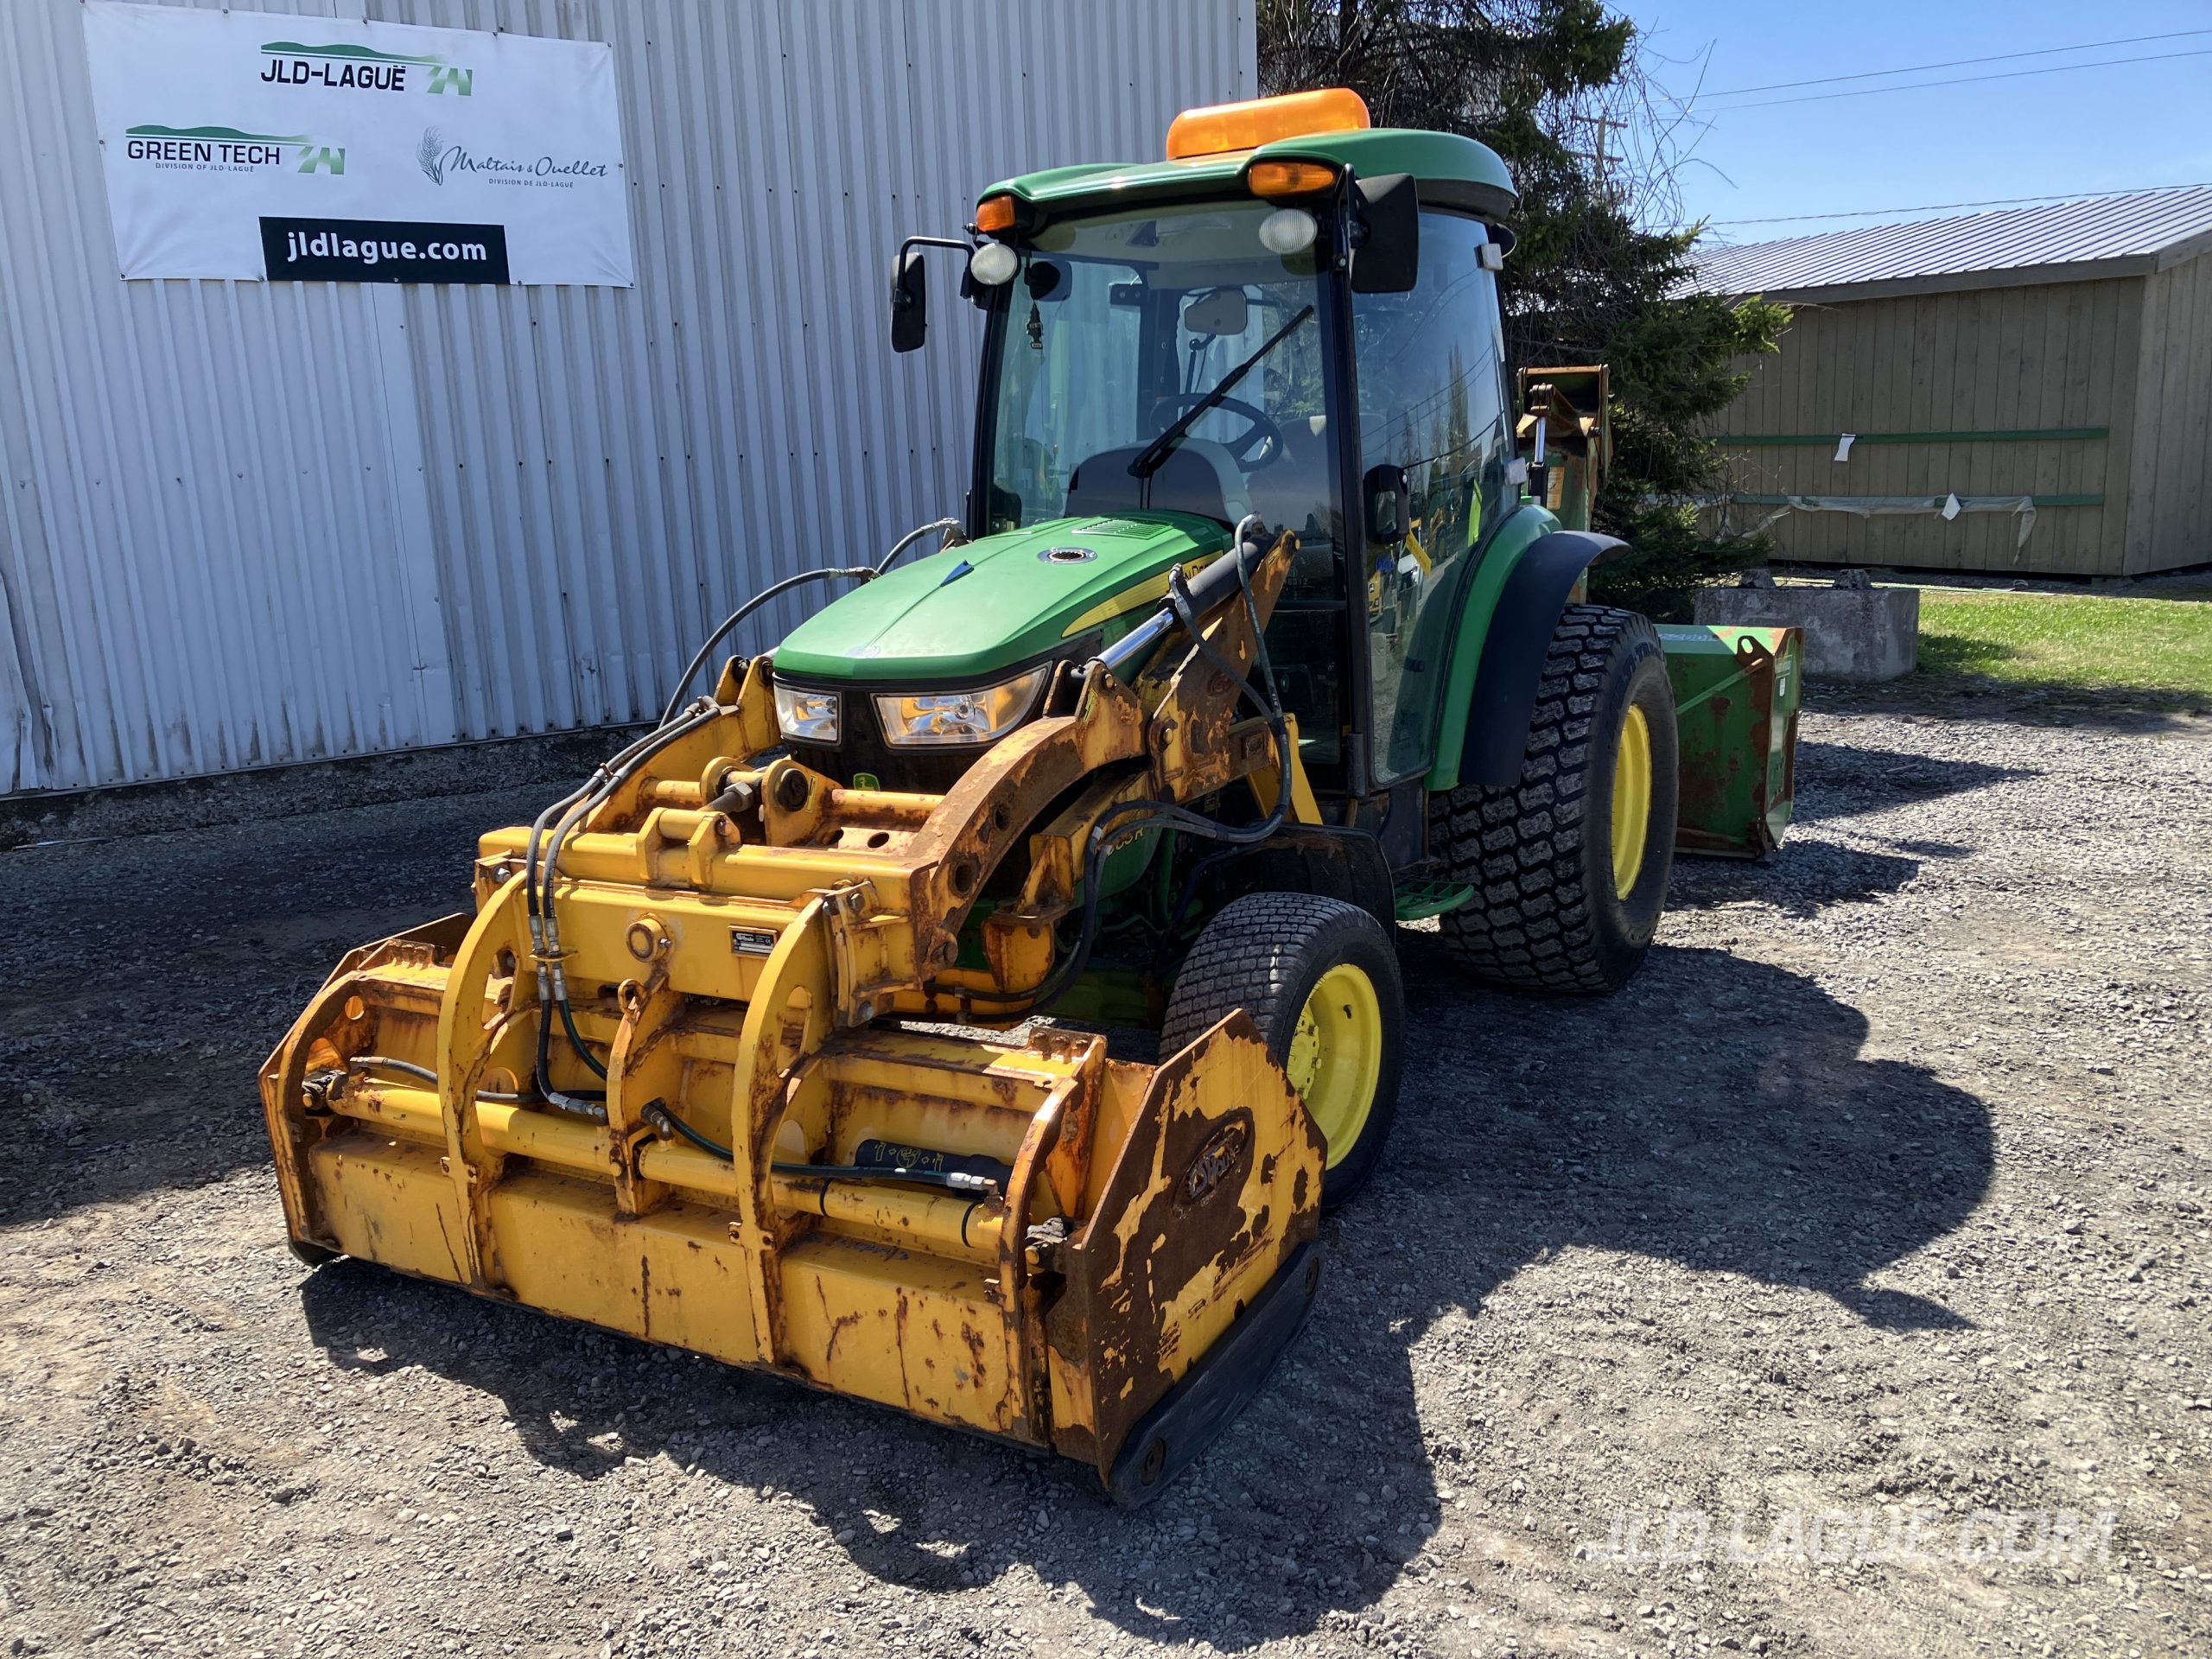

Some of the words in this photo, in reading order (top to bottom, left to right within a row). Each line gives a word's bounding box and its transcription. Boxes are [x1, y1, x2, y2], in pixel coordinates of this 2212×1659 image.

[127, 140, 212, 162] GREEN
[218, 144, 281, 165] TECH
[156, 162, 194, 170] DIVISION
[441, 145, 523, 174] Maltais
[535, 156, 608, 177] Ouellet
[287, 231, 487, 264] jldlague.com
